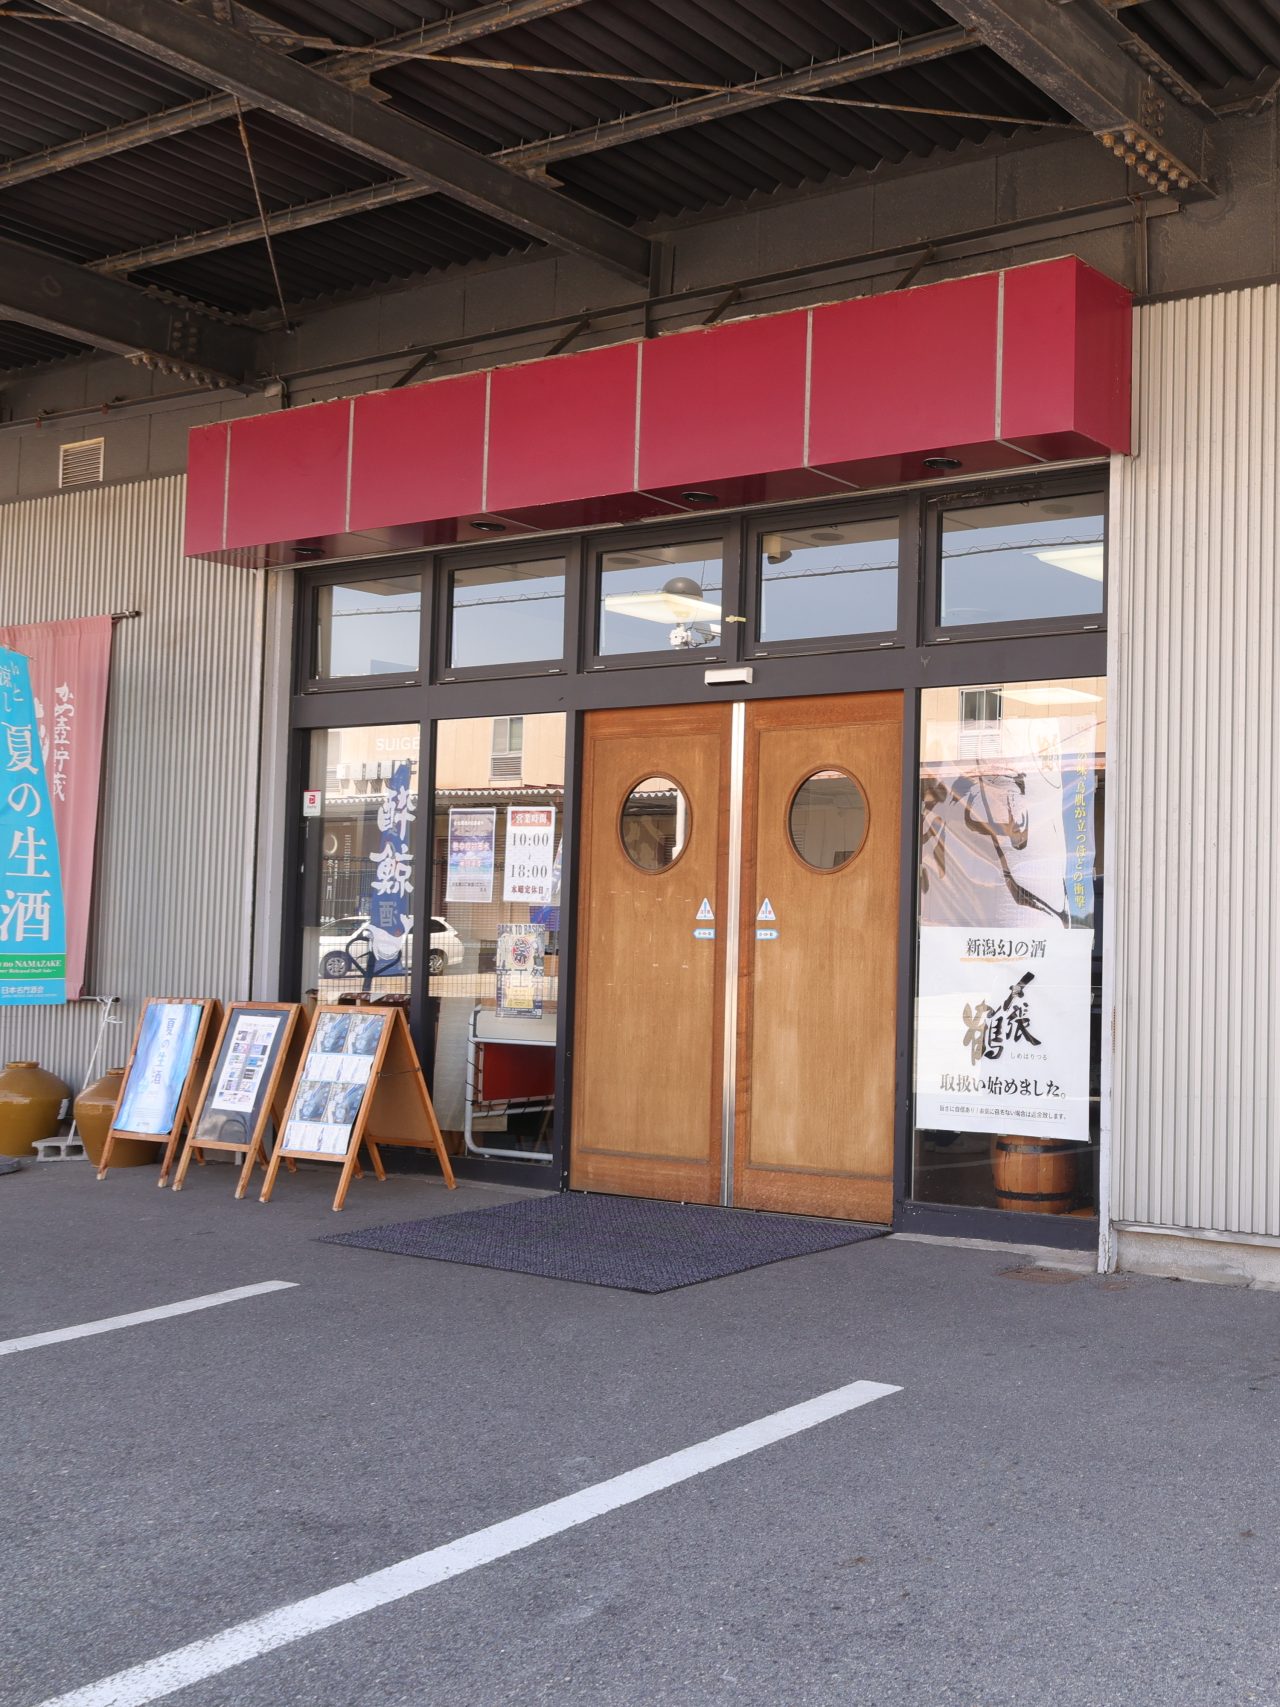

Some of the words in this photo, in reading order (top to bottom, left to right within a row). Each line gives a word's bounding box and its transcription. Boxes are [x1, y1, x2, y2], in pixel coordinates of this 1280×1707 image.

[0, 720, 51, 943] 夏の生酒
[512, 832, 549, 847] 10:00
[511, 863, 548, 878] 18:00
[966, 937, 1047, 958] 新潟幻の酒
[15, 959, 62, 968] NAMAZAKE
[939, 1073, 1067, 1100] 取扱い始めました。
